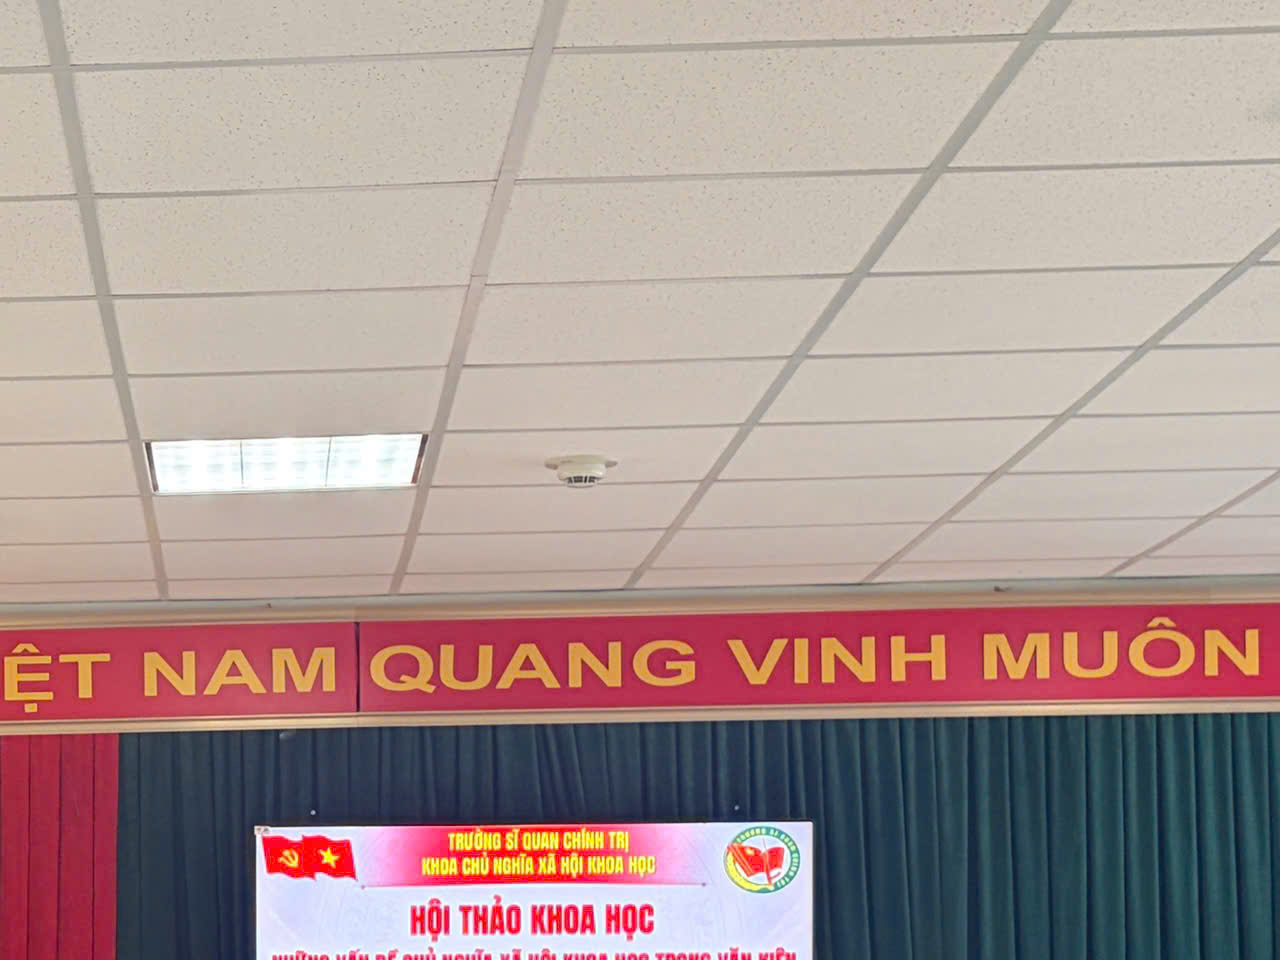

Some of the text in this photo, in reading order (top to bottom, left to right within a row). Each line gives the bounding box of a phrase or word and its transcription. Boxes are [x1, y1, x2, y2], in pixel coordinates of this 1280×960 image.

[142, 646, 336, 697] NAM
[370, 640, 696, 694] QUANG
[726, 634, 948, 685] VINH
[982, 616, 1260, 680] MUÔN
[449, 828, 629, 853] TRƯỜNG SĨ QUAN CHÍNH TRỊ
[422, 852, 656, 878] KHOA CHỦ NGHĨA XÃ HỘI KHOA HỌC
[410, 895, 655, 942] HỘI THẢO KHOA HỌC
